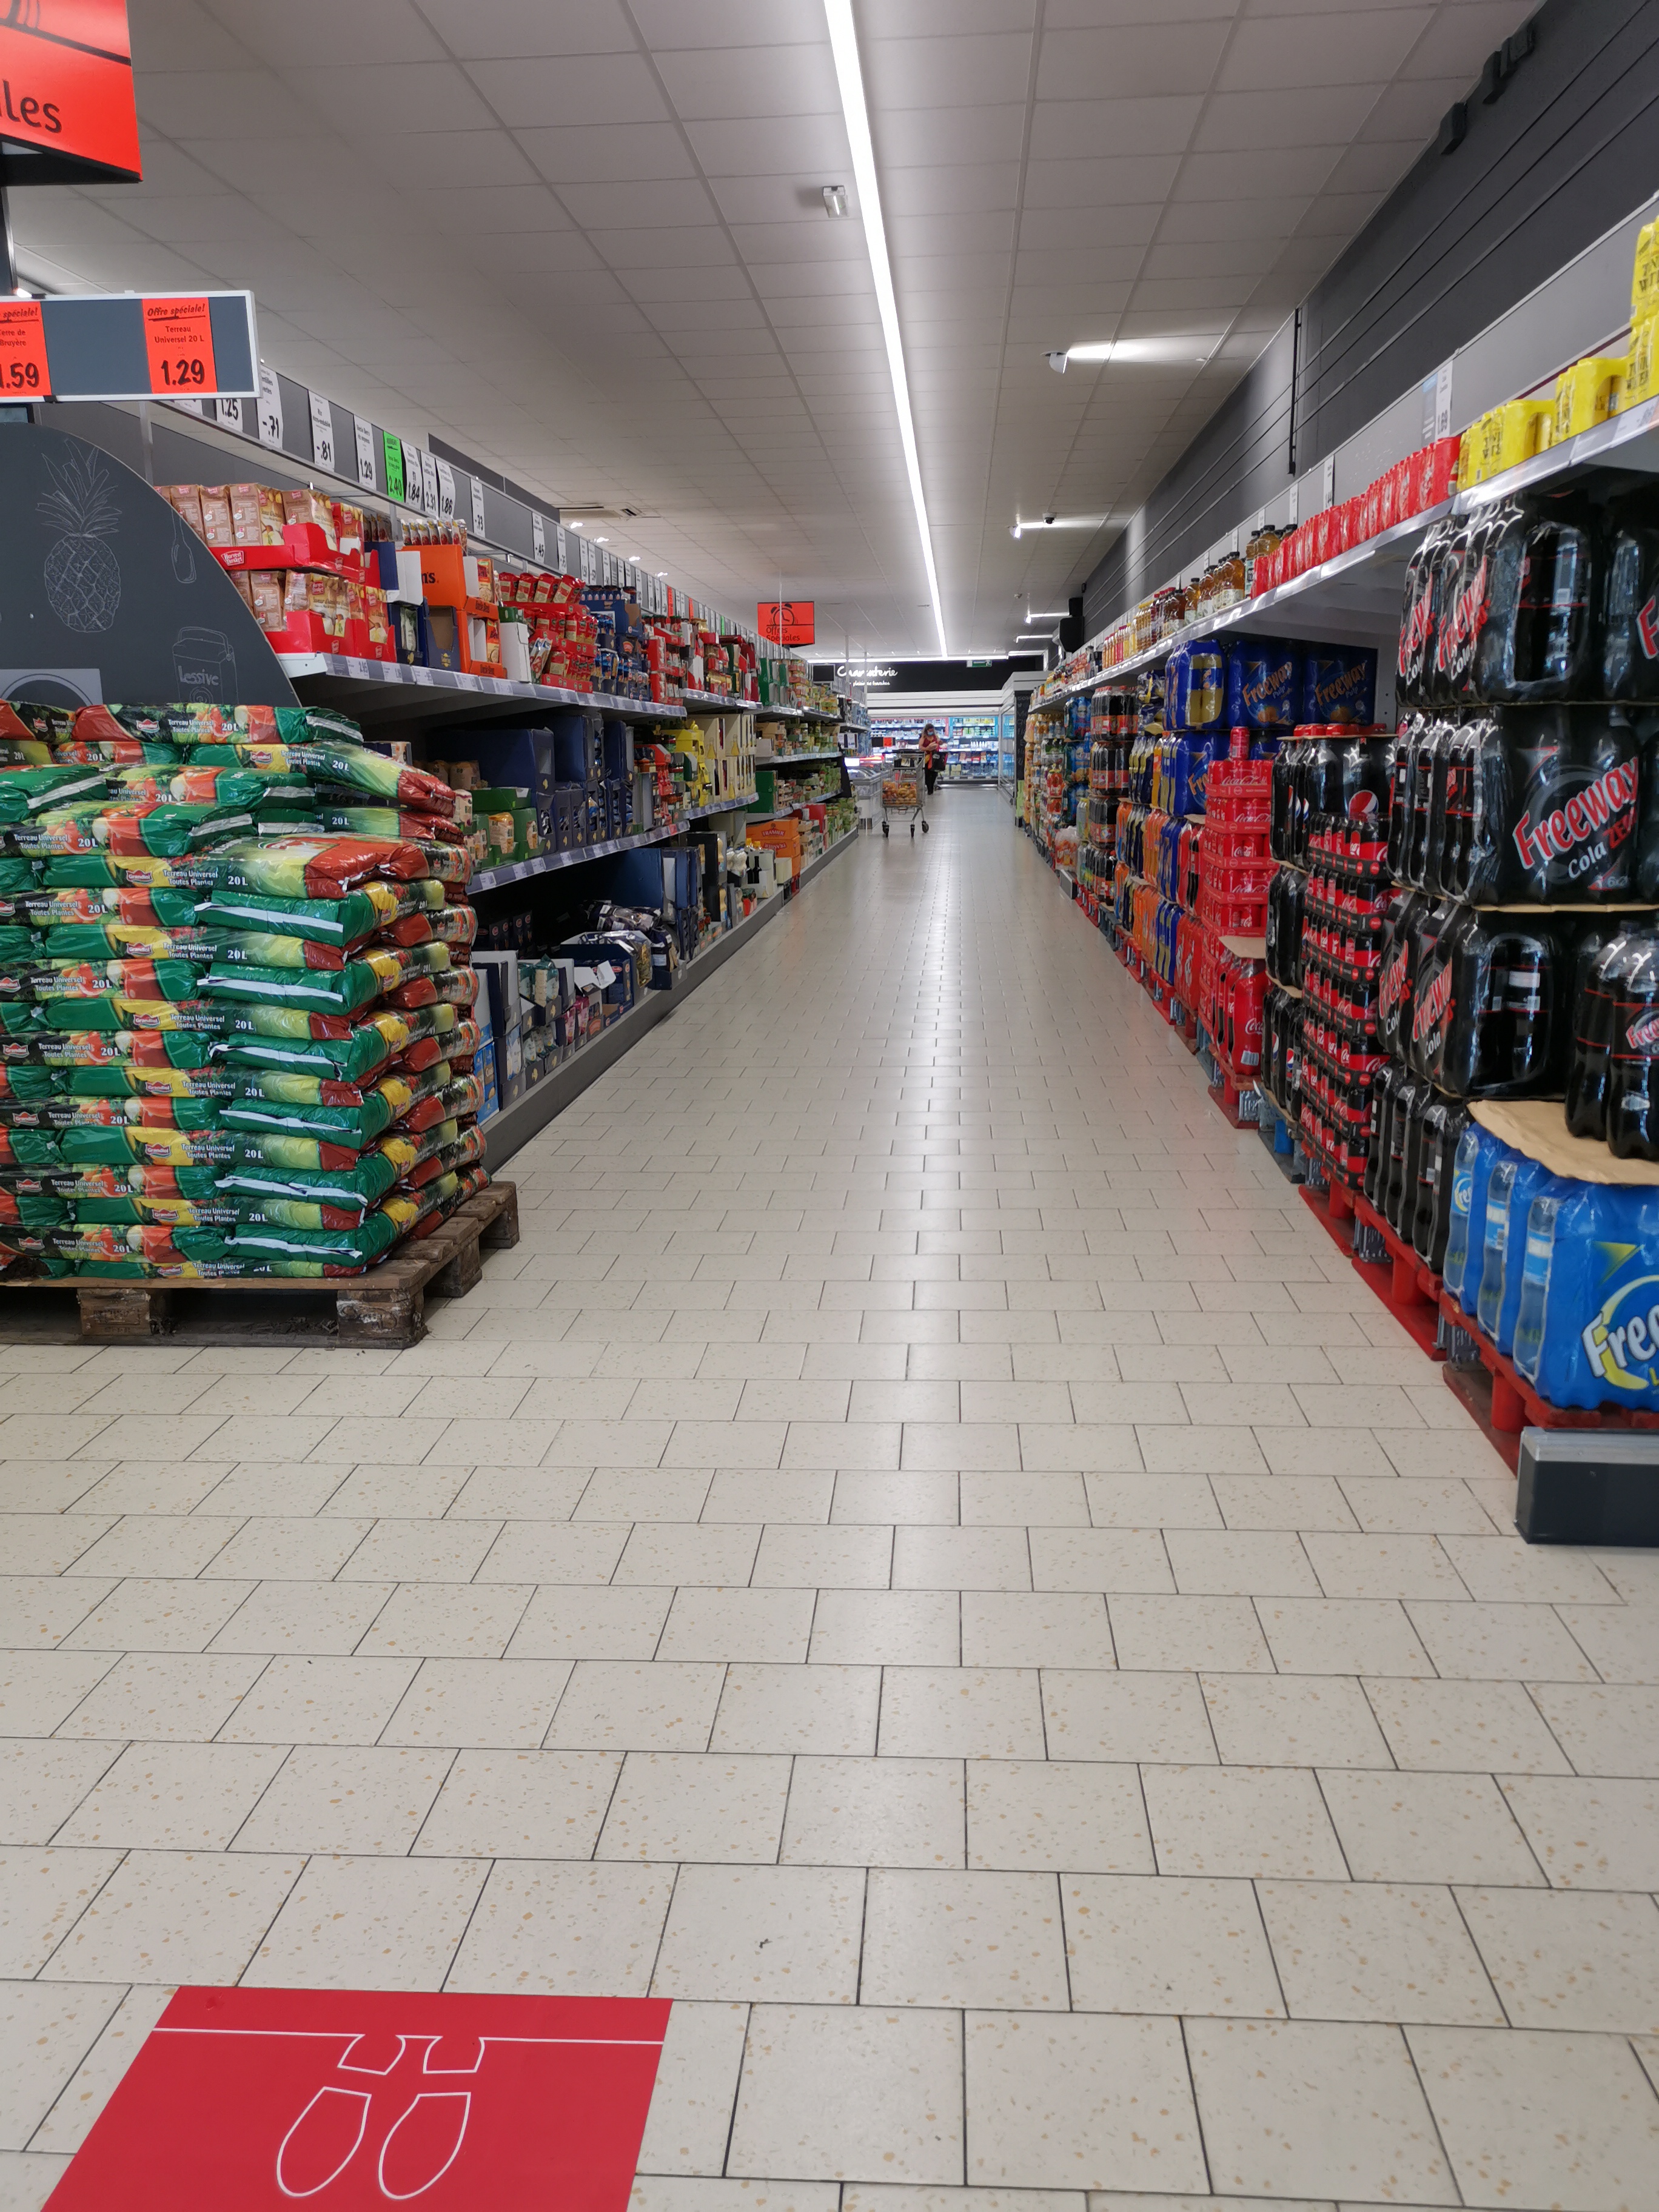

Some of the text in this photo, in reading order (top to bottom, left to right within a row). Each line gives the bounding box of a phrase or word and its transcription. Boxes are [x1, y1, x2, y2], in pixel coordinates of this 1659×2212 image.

[0, 80, 62, 133] les
[147, 303, 205, 318] Offre spéciale!
[161, 358, 206, 386] 1.29
[360, 458, 373, 481] 1.29
[389, 475, 402, 497] 2.40
[408, 481, 420, 503] 1.84
[426, 492, 437, 511] 2.31
[441, 495, 453, 515] 1.86
[179, 666, 219, 685] Lessive
[1242, 661, 1293, 706] Freeway
[1315, 660, 1368, 706] Freeway
[1513, 757, 1638, 870] Freeway
[1568, 841, 1607, 879] Cola
